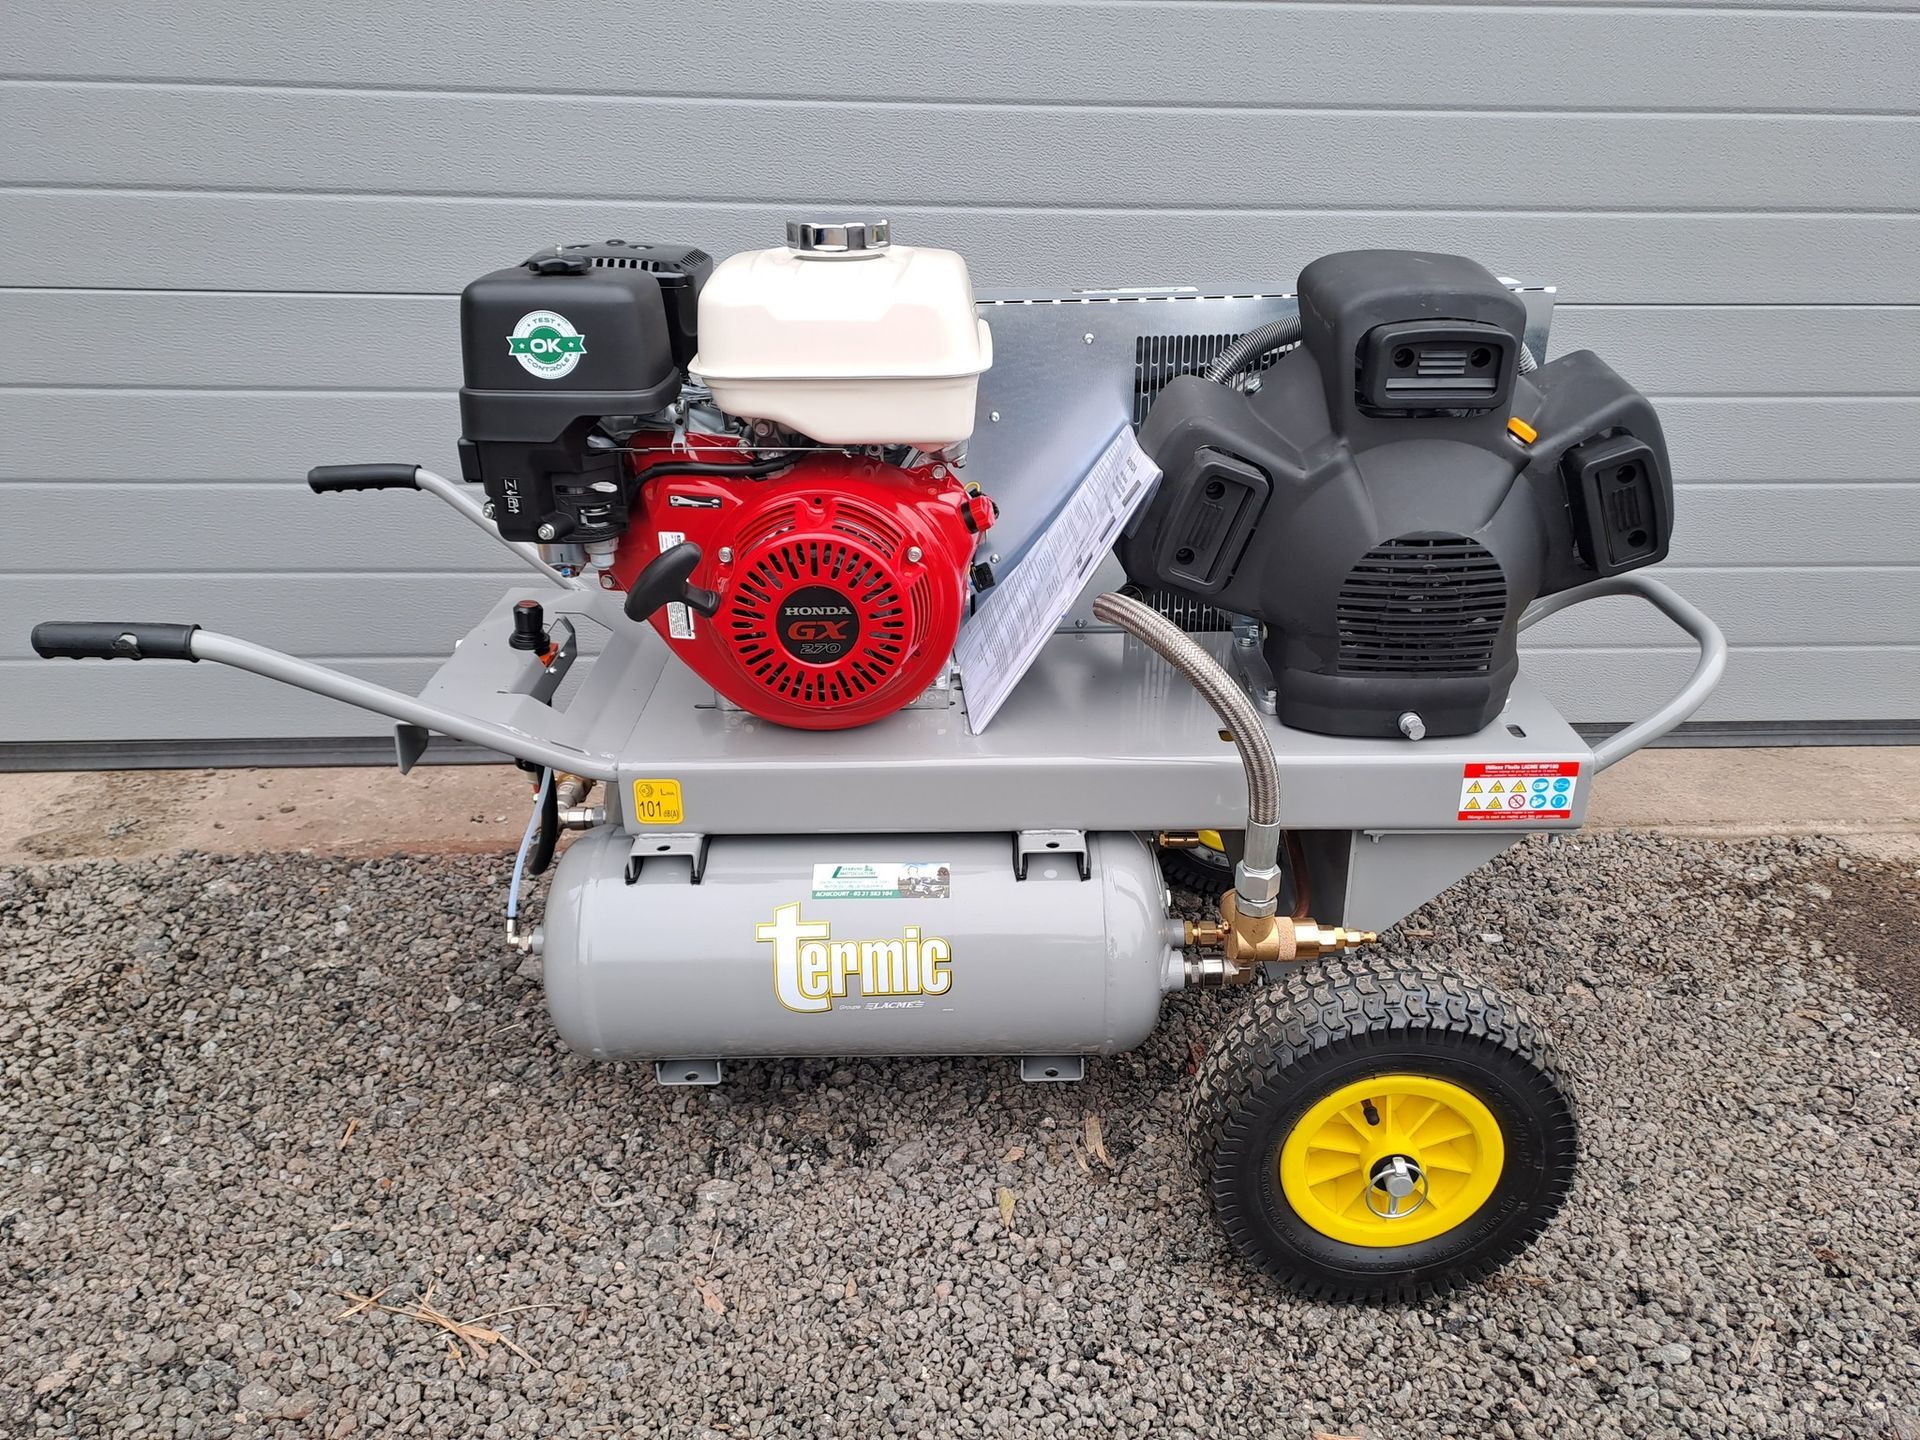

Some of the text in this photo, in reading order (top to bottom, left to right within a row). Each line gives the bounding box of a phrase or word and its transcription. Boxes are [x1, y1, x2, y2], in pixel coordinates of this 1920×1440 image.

[529, 338, 564, 353] OK
[784, 606, 852, 616] HONDA
[788, 620, 850, 640] GX
[800, 643, 841, 655] 270
[639, 800, 662, 817] 101
[756, 901, 952, 1013] termic
